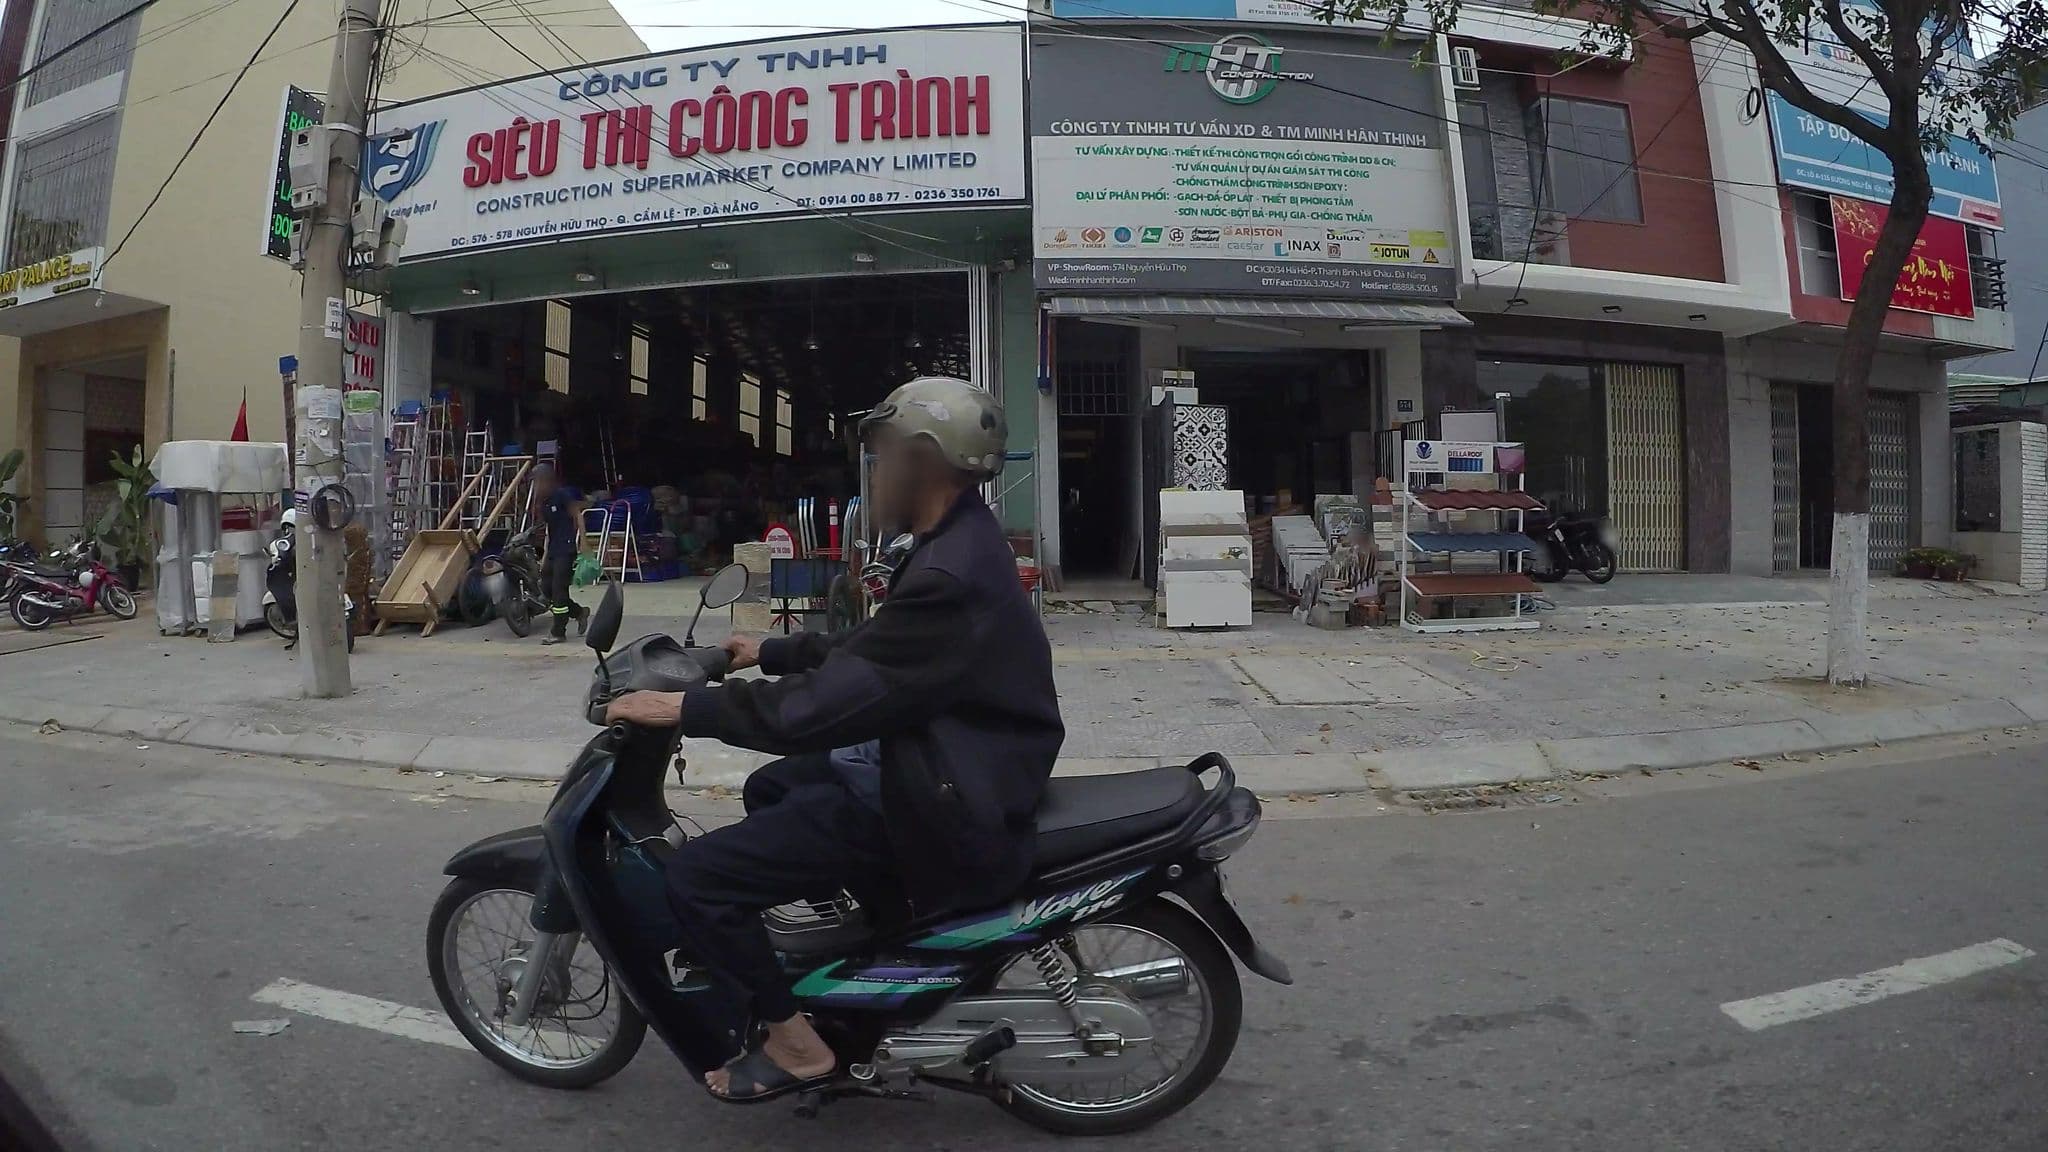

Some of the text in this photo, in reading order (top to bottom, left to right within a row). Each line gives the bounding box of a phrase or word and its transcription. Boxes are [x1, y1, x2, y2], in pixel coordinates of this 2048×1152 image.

[559, 44, 887, 100] CÔNG TY TNHH
[1220, 71, 1314, 80] CONSTRUCTION
[463, 69, 990, 188] SIÊU THỊ CÔNG TRÌNH
[1050, 119, 1097, 134] CÔNG
[1100, 121, 1121, 134] TY
[1126, 122, 1170, 134] TNHH
[1173, 121, 1196, 134] TƯ
[1199, 119, 1231, 135] VẤN
[1233, 124, 1255, 137] XD
[1261, 125, 1273, 138] &
[1277, 125, 1300, 139] TM
[1304, 127, 1344, 141] MINH
[1382, 131, 1427, 148] THỊNH
[1075, 146, 1091, 155] TƯ
[1092, 144, 1115, 156] VẤN
[1116, 145, 1136, 156] XÂY
[1331, 151, 1358, 164] TRÌNH
[1374, 157, 1381, 165] &
[1797, 115, 1824, 137] TẬP
[1940, 150, 1980, 176] THÀNH
[476, 151, 977, 215] CONSTRUCTION SUPERMARKET COMPANY LIMITED
[1327, 168, 1343, 177] THI
[1076, 191, 1094, 203] ĐẠI
[1097, 188, 1108, 200] LÝ
[1109, 189, 1139, 200] PHÂN
[472, 234, 488, 244] 576
[496, 229, 513, 240] 578
[516, 220, 557, 237] NGUYỄN
[560, 218, 582, 231] HỮU
[586, 217, 608, 229] THỌ
[617, 214, 630, 224] Q.
[633, 207, 661, 222] CẨM
[663, 207, 675, 222] LỆ
[684, 207, 700, 217] TP.
[703, 202, 719, 215] ĐÀ
[722, 200, 760, 213] NẴNG
[819, 195, 847, 206] 0914
[850, 194, 866, 204] 00
[868, 193, 883, 203] 88
[886, 191, 900, 202] 77
[914, 190, 946, 200] 0236
[951, 188, 974, 198] 350
[976, 187, 1000, 198] 1761
[1234, 228, 1283, 237] ARISTON
[1287, 240, 1321, 251] INAX
[1326, 233, 1361, 241] Dulux
[1381, 248, 1410, 259] JOTUN
[0, 270, 18, 293] RY
[20, 255, 72, 288] PALACE
[353, 352, 375, 383] THỊ
[1011, 872, 1143, 930] Wave
